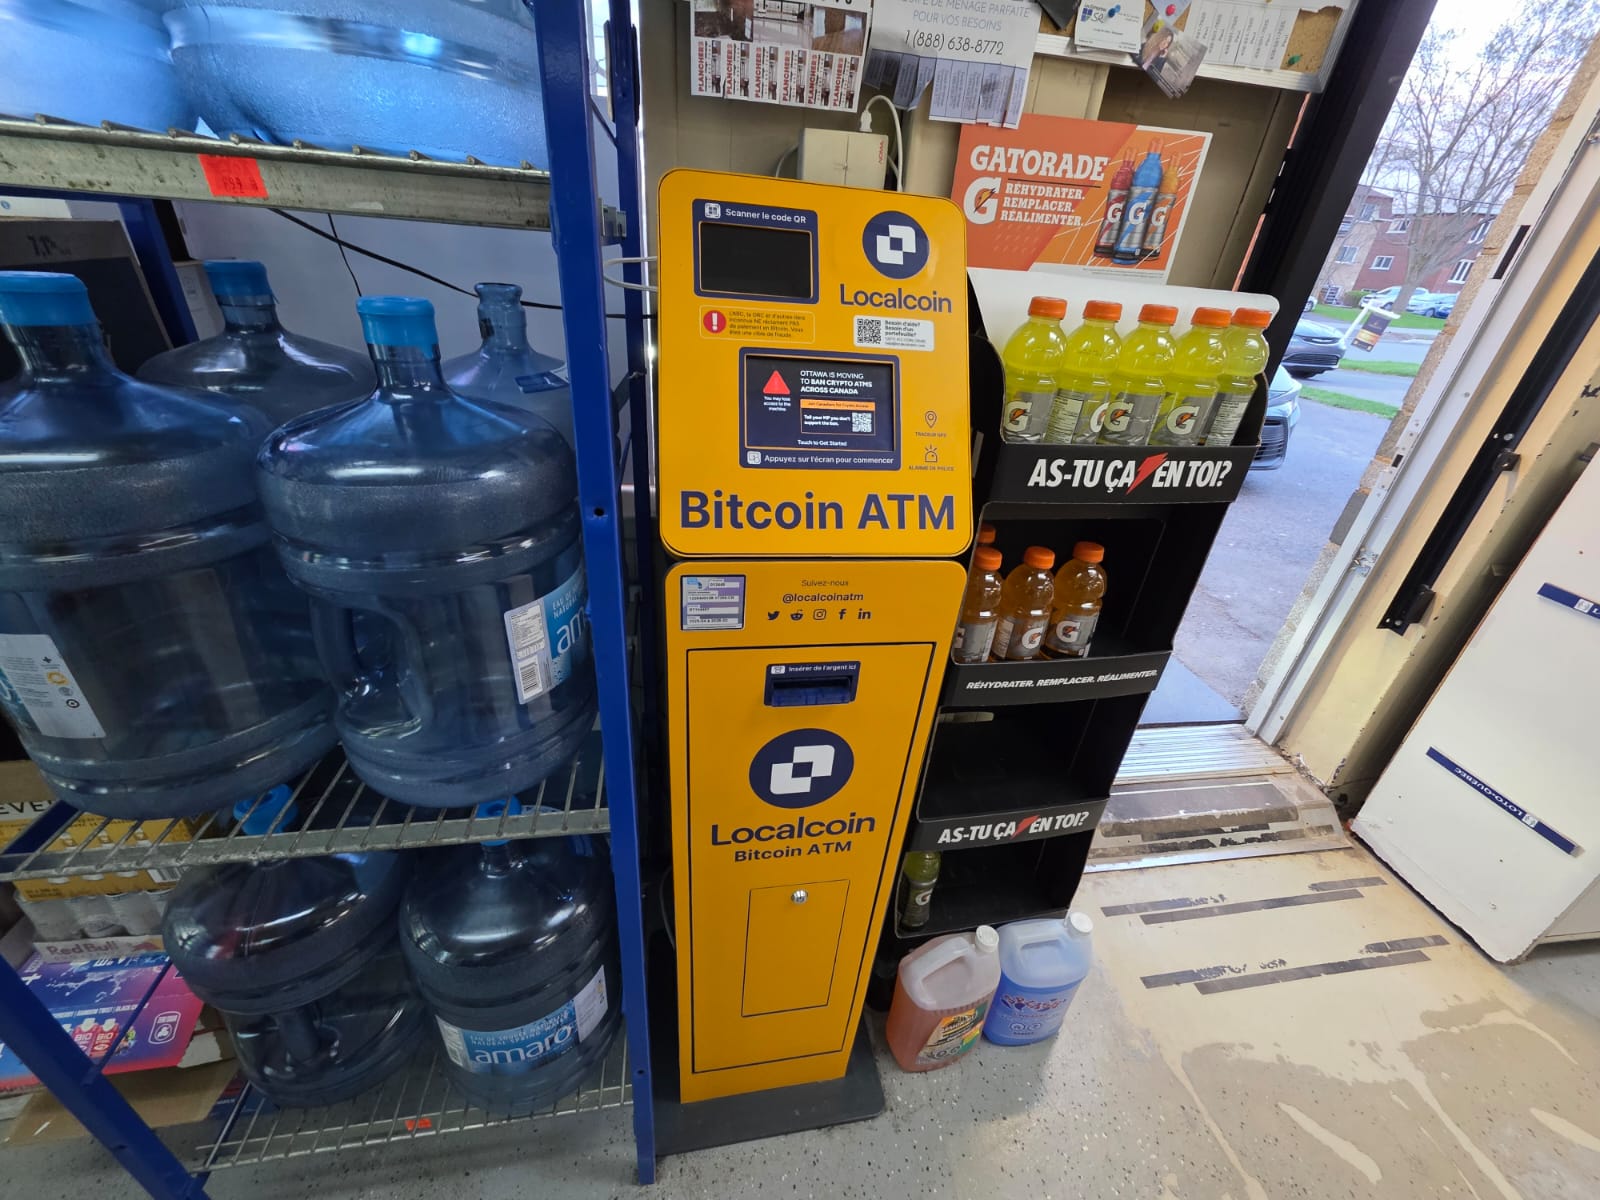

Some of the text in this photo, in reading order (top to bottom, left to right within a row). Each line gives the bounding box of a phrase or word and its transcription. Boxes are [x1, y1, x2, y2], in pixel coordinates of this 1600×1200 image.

[913, 10, 1002, 31] POUR VOS BESOINS
[989, 3, 1030, 18] PARFAITE
[905, 29, 1004, 56] 1 (888) 638-8772
[783, 50, 791, 102] PLANCHERS
[808, 54, 818, 105] PLANCHERS
[833, 57, 844, 107] PLANCHERS
[970, 144, 1109, 182] GATORADE
[963, 176, 1002, 225] G
[1003, 196, 1075, 213] REMPLACER.
[725, 208, 807, 224] Scanner le code QR
[839, 283, 952, 313] Localcoin
[800, 370, 864, 379] OTTAWA IS MOVING
[811, 378, 826, 386] BAN
[826, 379, 854, 387] CRYPTO
[800, 386, 859, 395] ACROSS CANADA
[764, 455, 796, 465] Appuyez
[811, 456, 834, 464] l'écran
[836, 457, 852, 465] pour
[1027, 458, 1233, 493] AS-TU ÇA EN TOI?
[680, 489, 955, 530] Bitcoin ATM
[801, 579, 849, 587] Suivez-nous
[782, 592, 864, 604] @localcoinatm
[966, 669, 1158, 690] RÉHYDRATER. REMPLACER. RÉALIMENTER.
[711, 812, 876, 846] Localcoin
[937, 811, 1090, 844] AS-TU ÇA EN TOI?
[734, 840, 852, 863] Bitcoin ATM
[46, 940, 118, 955] Red Bull
[75, 1032, 92, 1041] BIO
[96, 1032, 114, 1041] BIO
[475, 1024, 573, 1064] amaro
